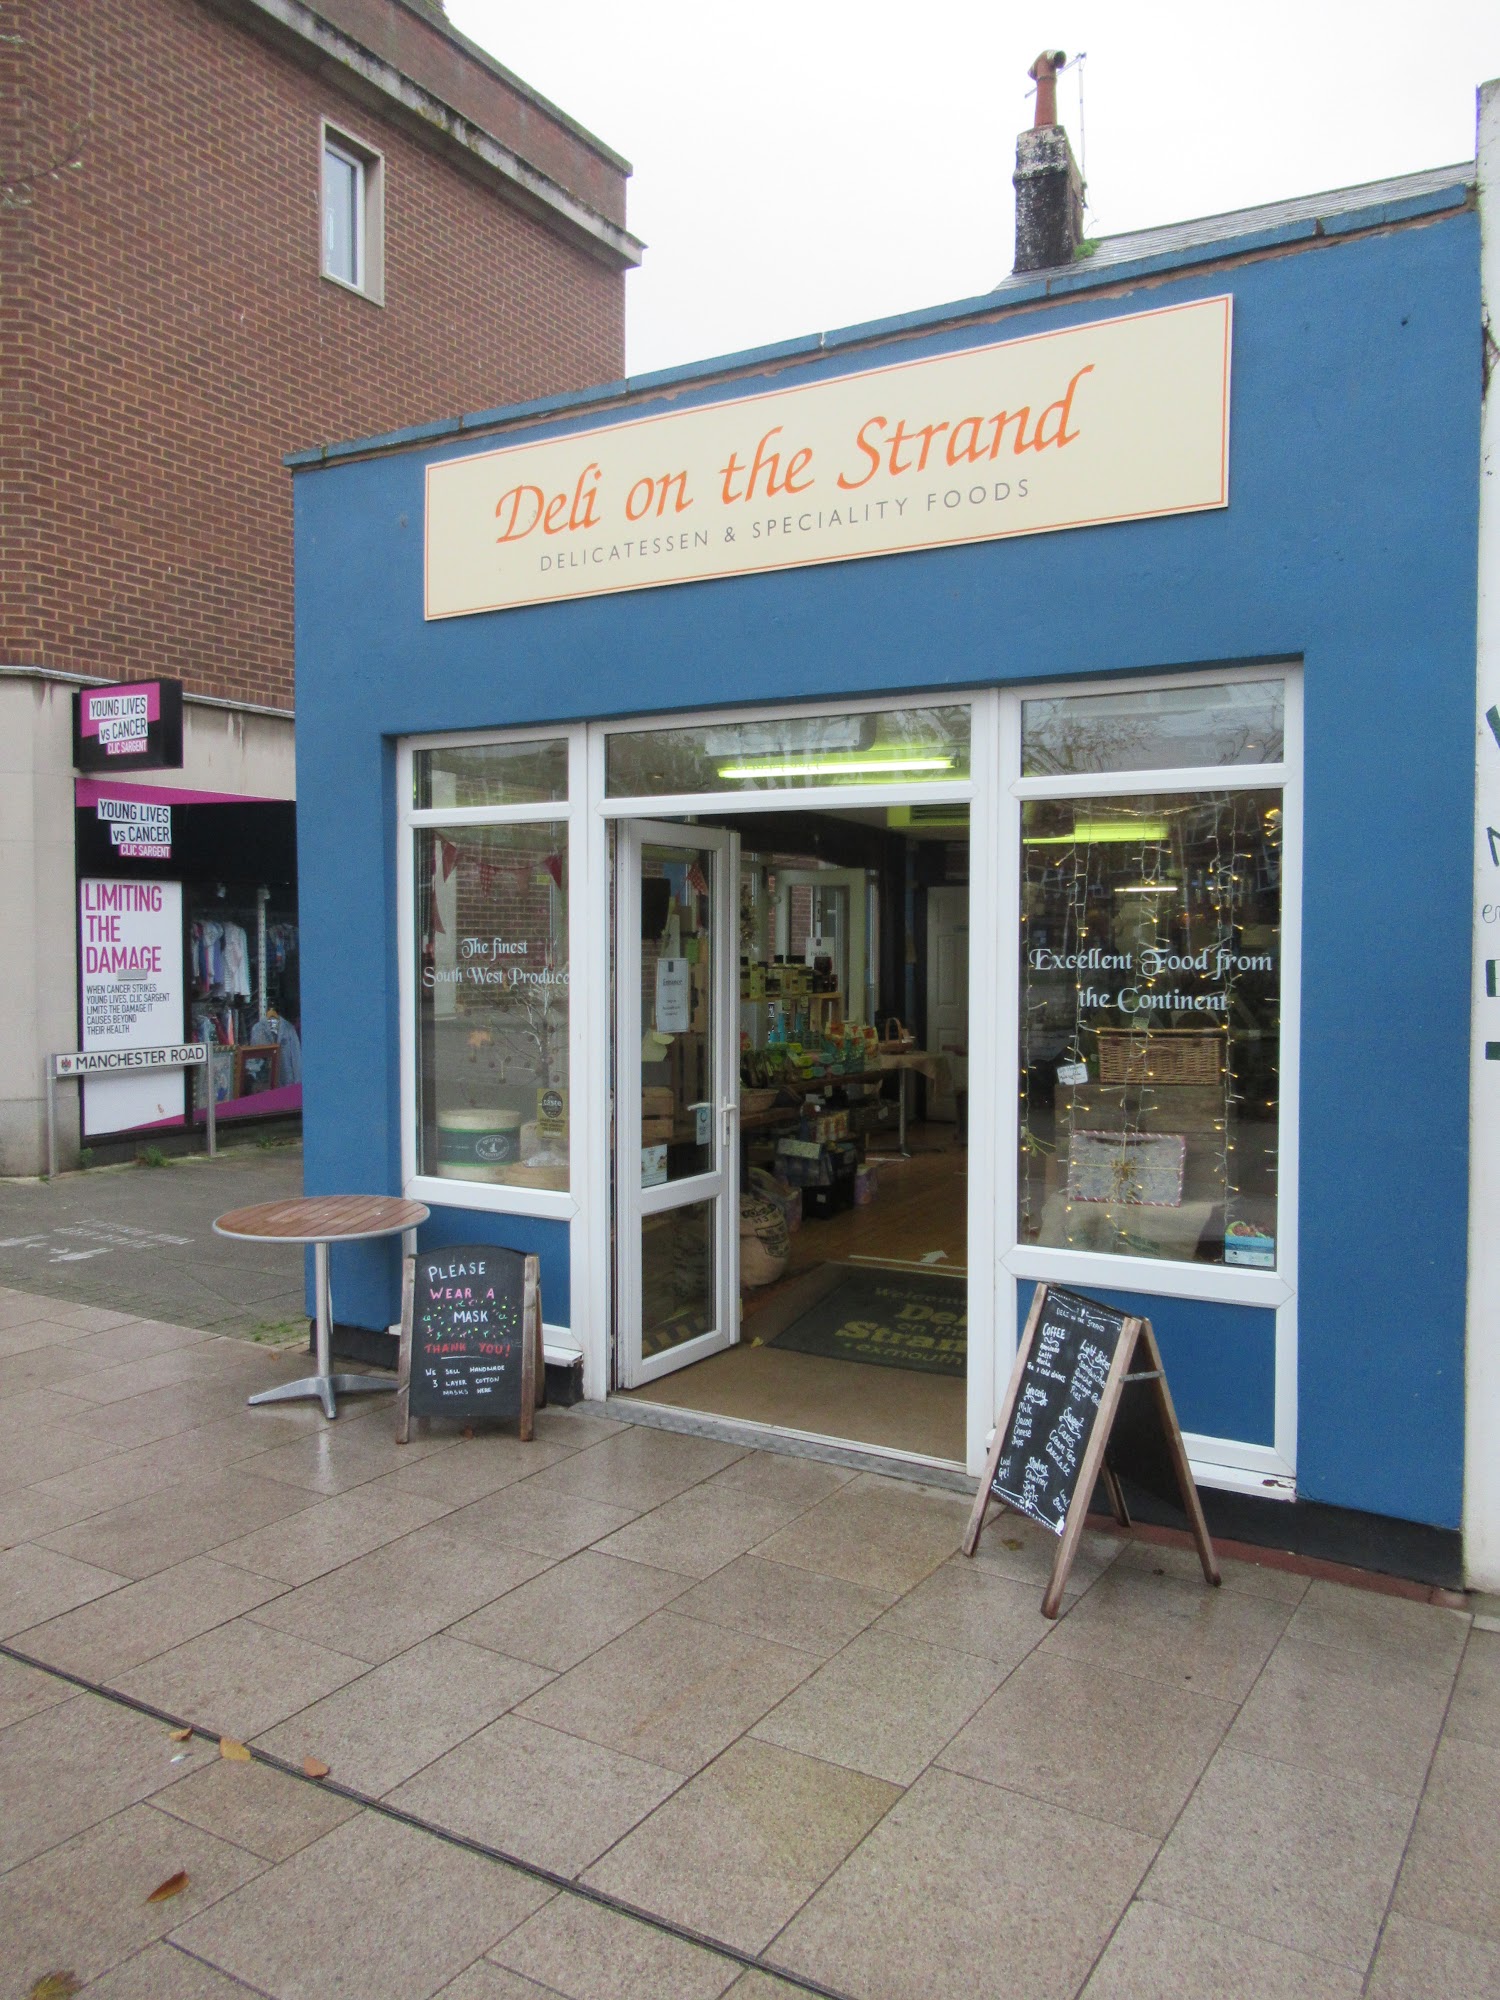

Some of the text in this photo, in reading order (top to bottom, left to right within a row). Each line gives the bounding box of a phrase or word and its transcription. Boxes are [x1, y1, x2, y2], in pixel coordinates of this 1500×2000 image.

[495, 363, 1094, 545] Deli on the Strand
[539, 478, 1031, 573] DELICATESSEN & SPECIALITY FOODS
[90, 696, 147, 718] YOUNG LIVES
[112, 717, 147, 740] CANCER
[108, 739, 147, 754] CLIC SARGENT
[99, 801, 169, 824] YOUNG LIVES
[128, 826, 170, 842] CANCER
[120, 845, 170, 858] CLIC SARGENT
[85, 883, 162, 912] LIMITING
[86, 915, 121, 942] THE
[461, 938, 528, 961] The finest
[86, 946, 162, 974] DAMAGE
[1029, 948, 1273, 980] Excellent Food from
[423, 966, 569, 987] South West Produce
[87, 983, 157, 994] WHEN CANCER STRIKES
[87, 995, 108, 1004] YOUNG
[129, 994, 142, 1003] CLIC
[144, 993, 170, 1002] SARGENT
[87, 1005, 108, 1015] LIMITS
[109, 1004, 121, 1014] THE
[121, 1004, 147, 1013] DAMAGE
[1078, 987, 1228, 1013] the Continent
[87, 1014, 137, 1025] CAUSES BEYOND
[87, 1025, 130, 1035] THEIR HEALTH
[76, 1047, 204, 1070] MANCHESTER ROAD
[428, 1262, 486, 1282] PLEASE
[430, 1288, 495, 1300] WEAR A
[453, 1310, 489, 1323] MASK
[834, 1320, 967, 1354] Stran
[425, 1343, 511, 1358] THANK YOU!
[432, 1379, 438, 1388] 3
[475, 1376, 500, 1384] COTTON
[443, 1388, 468, 1396] MASKS
[1019, 1402, 1032, 1415] Milk
